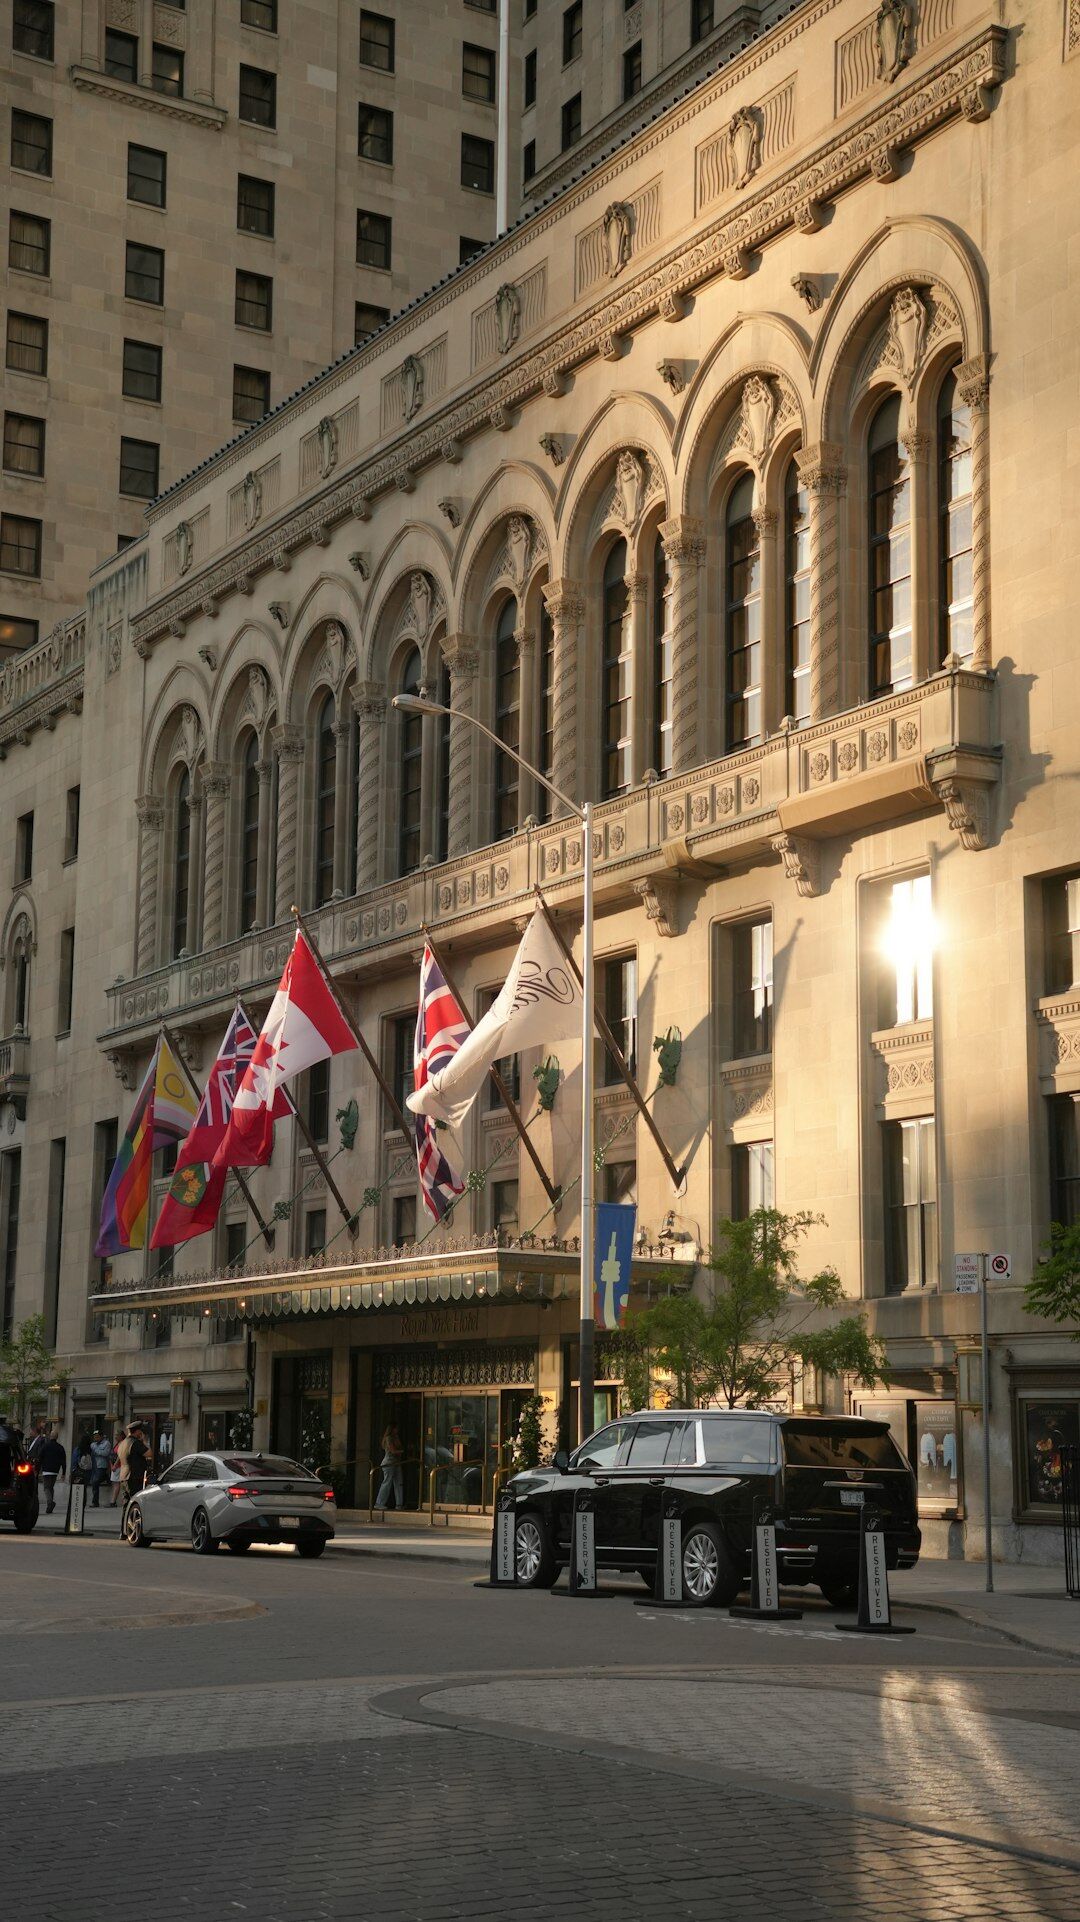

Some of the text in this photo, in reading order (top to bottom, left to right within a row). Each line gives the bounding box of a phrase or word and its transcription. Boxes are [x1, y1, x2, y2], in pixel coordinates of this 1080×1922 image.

[400, 1311, 428, 1340] Royal
[453, 1309, 479, 1333] Hotel
[581, 1515, 589, 1585] RESERVED
[763, 1528, 772, 1607] RESERVED
[872, 1535, 881, 1619] RESERVED
